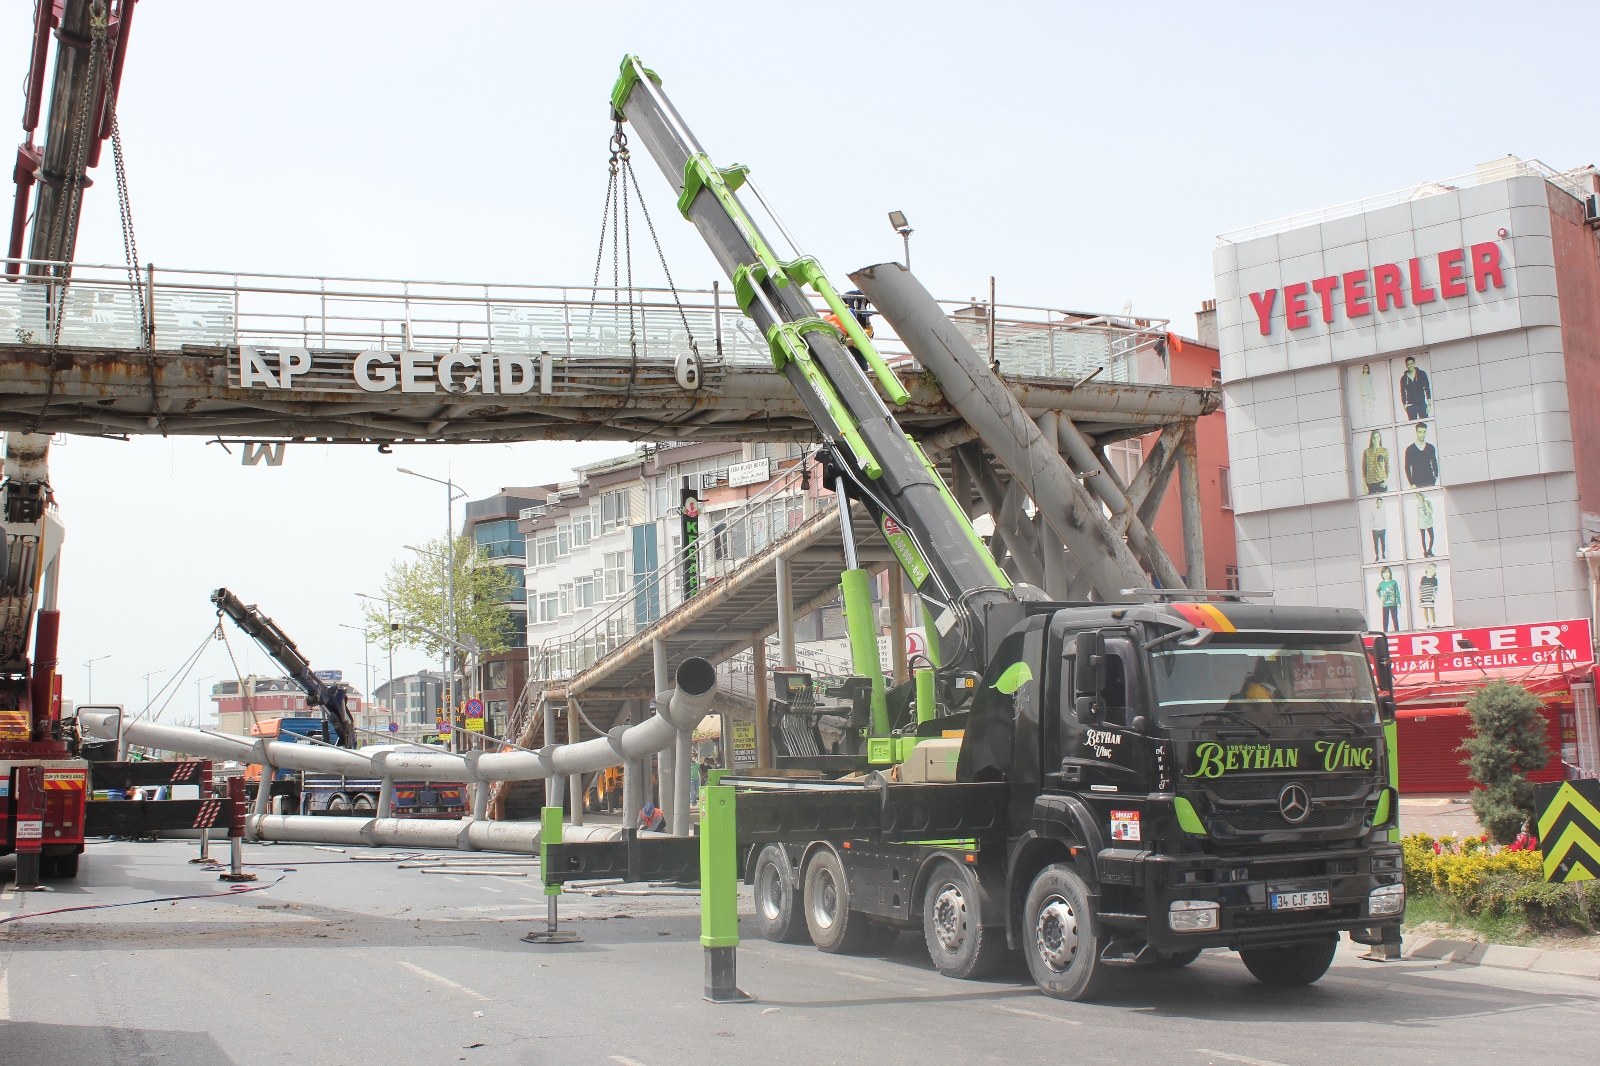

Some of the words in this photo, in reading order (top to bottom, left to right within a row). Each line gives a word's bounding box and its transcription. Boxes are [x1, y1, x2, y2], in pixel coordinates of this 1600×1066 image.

[1248, 241, 1507, 336] YETERLER
[239, 346, 314, 389] AP
[673, 351, 700, 390] 6
[902, 548, 914, 565] 000
[1387, 625, 1562, 658] ERLER
[1082, 729, 1122, 747] BEYHAN
[1227, 743, 1251, 751] 1989'dan
[1184, 742, 1299, 778] BEYHAN
[1277, 895, 1288, 907] 34
[1292, 893, 1308, 906] CJF
[1312, 892, 1328, 905] 353
